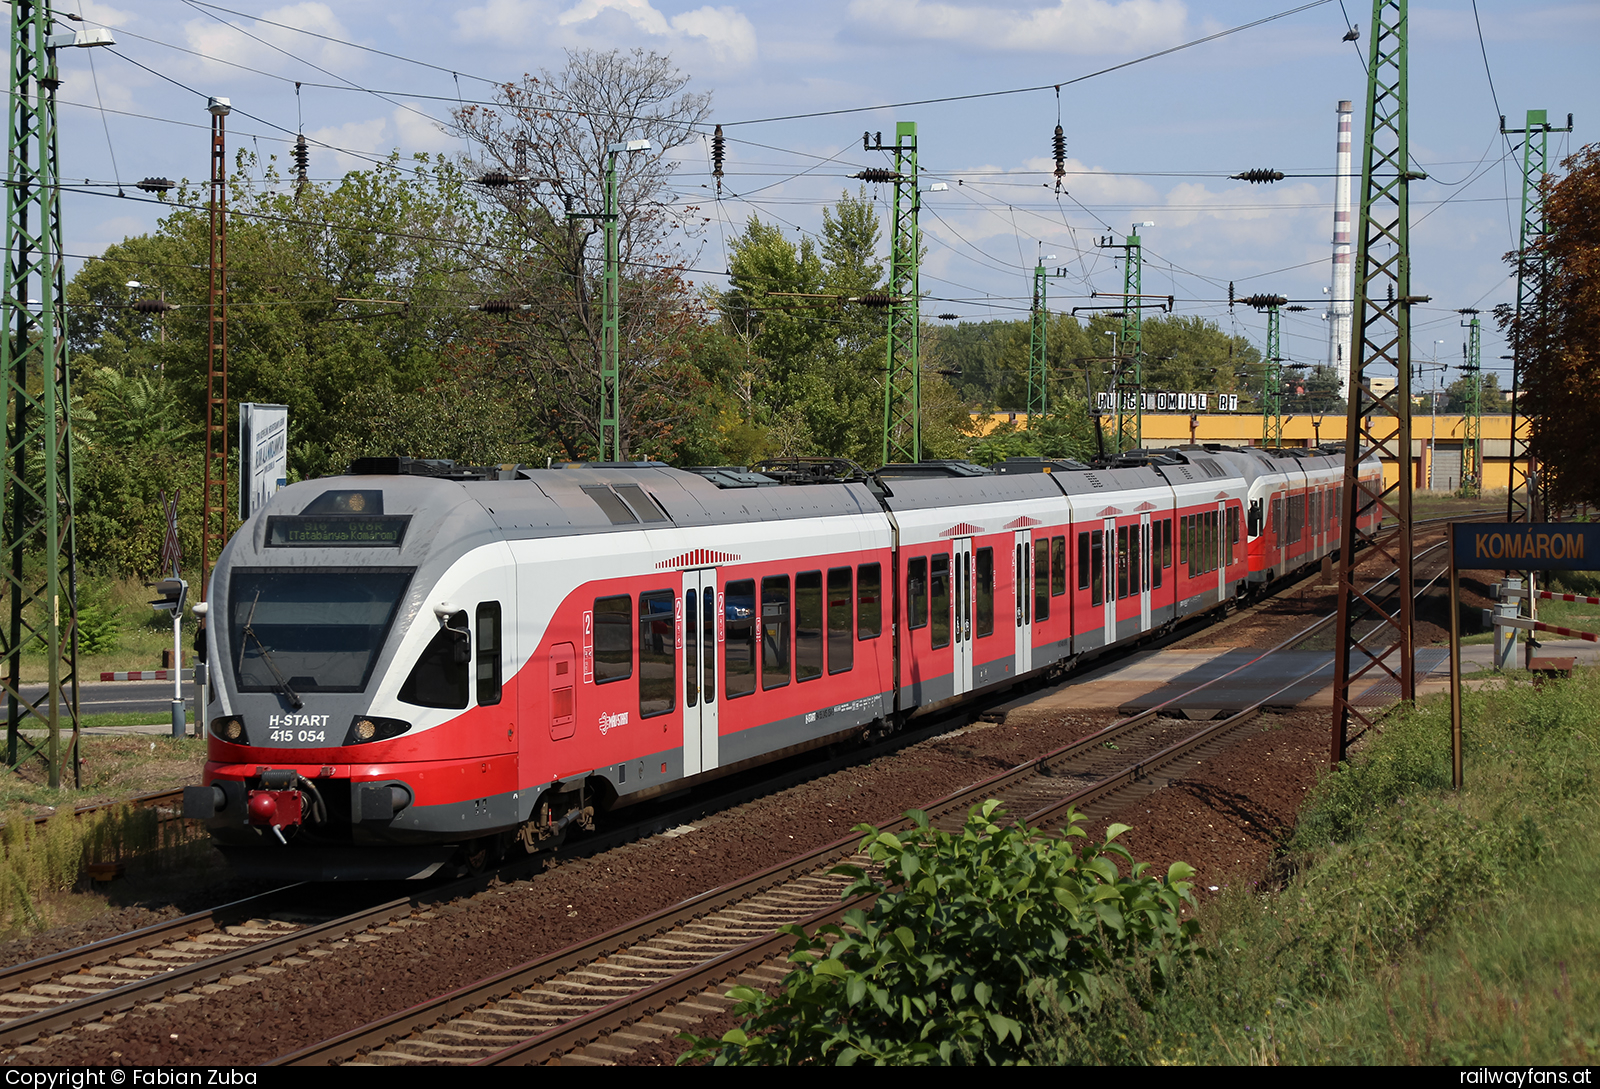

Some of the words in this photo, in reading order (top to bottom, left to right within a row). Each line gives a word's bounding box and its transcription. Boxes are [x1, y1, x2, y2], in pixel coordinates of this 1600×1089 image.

[1219, 394, 1238, 410] RT
[1475, 527, 1584, 559] KOMÁROM
[585, 614, 591, 635] 2
[269, 714, 330, 728] H-START
[270, 730, 293, 742] 415
[298, 730, 325, 742] 054
